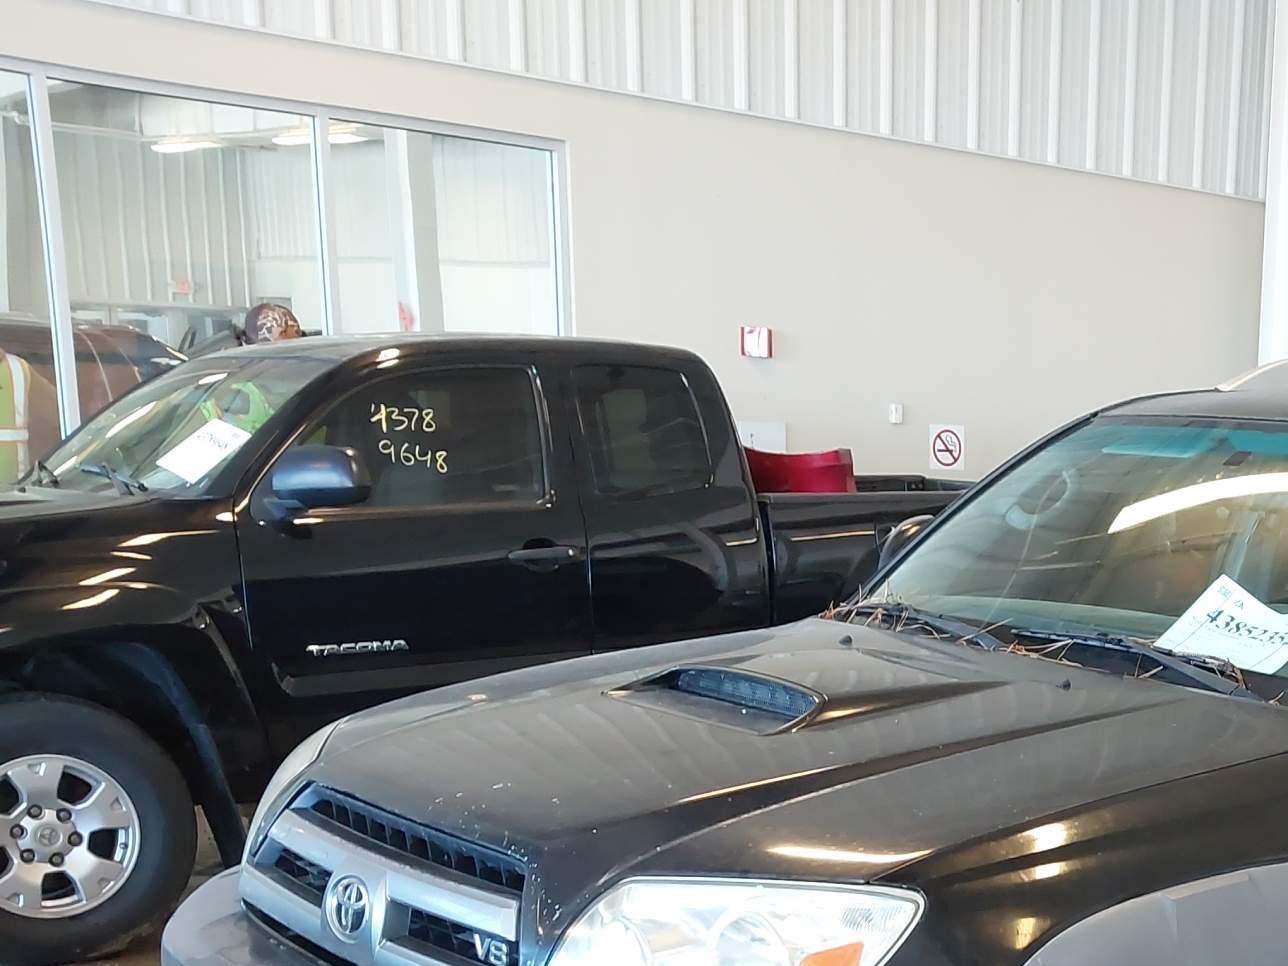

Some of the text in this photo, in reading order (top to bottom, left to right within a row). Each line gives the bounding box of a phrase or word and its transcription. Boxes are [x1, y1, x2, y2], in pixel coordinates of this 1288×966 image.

[370, 403, 436, 433] 4378
[378, 439, 448, 473] 9648
[306, 640, 409, 656] TACOMA
